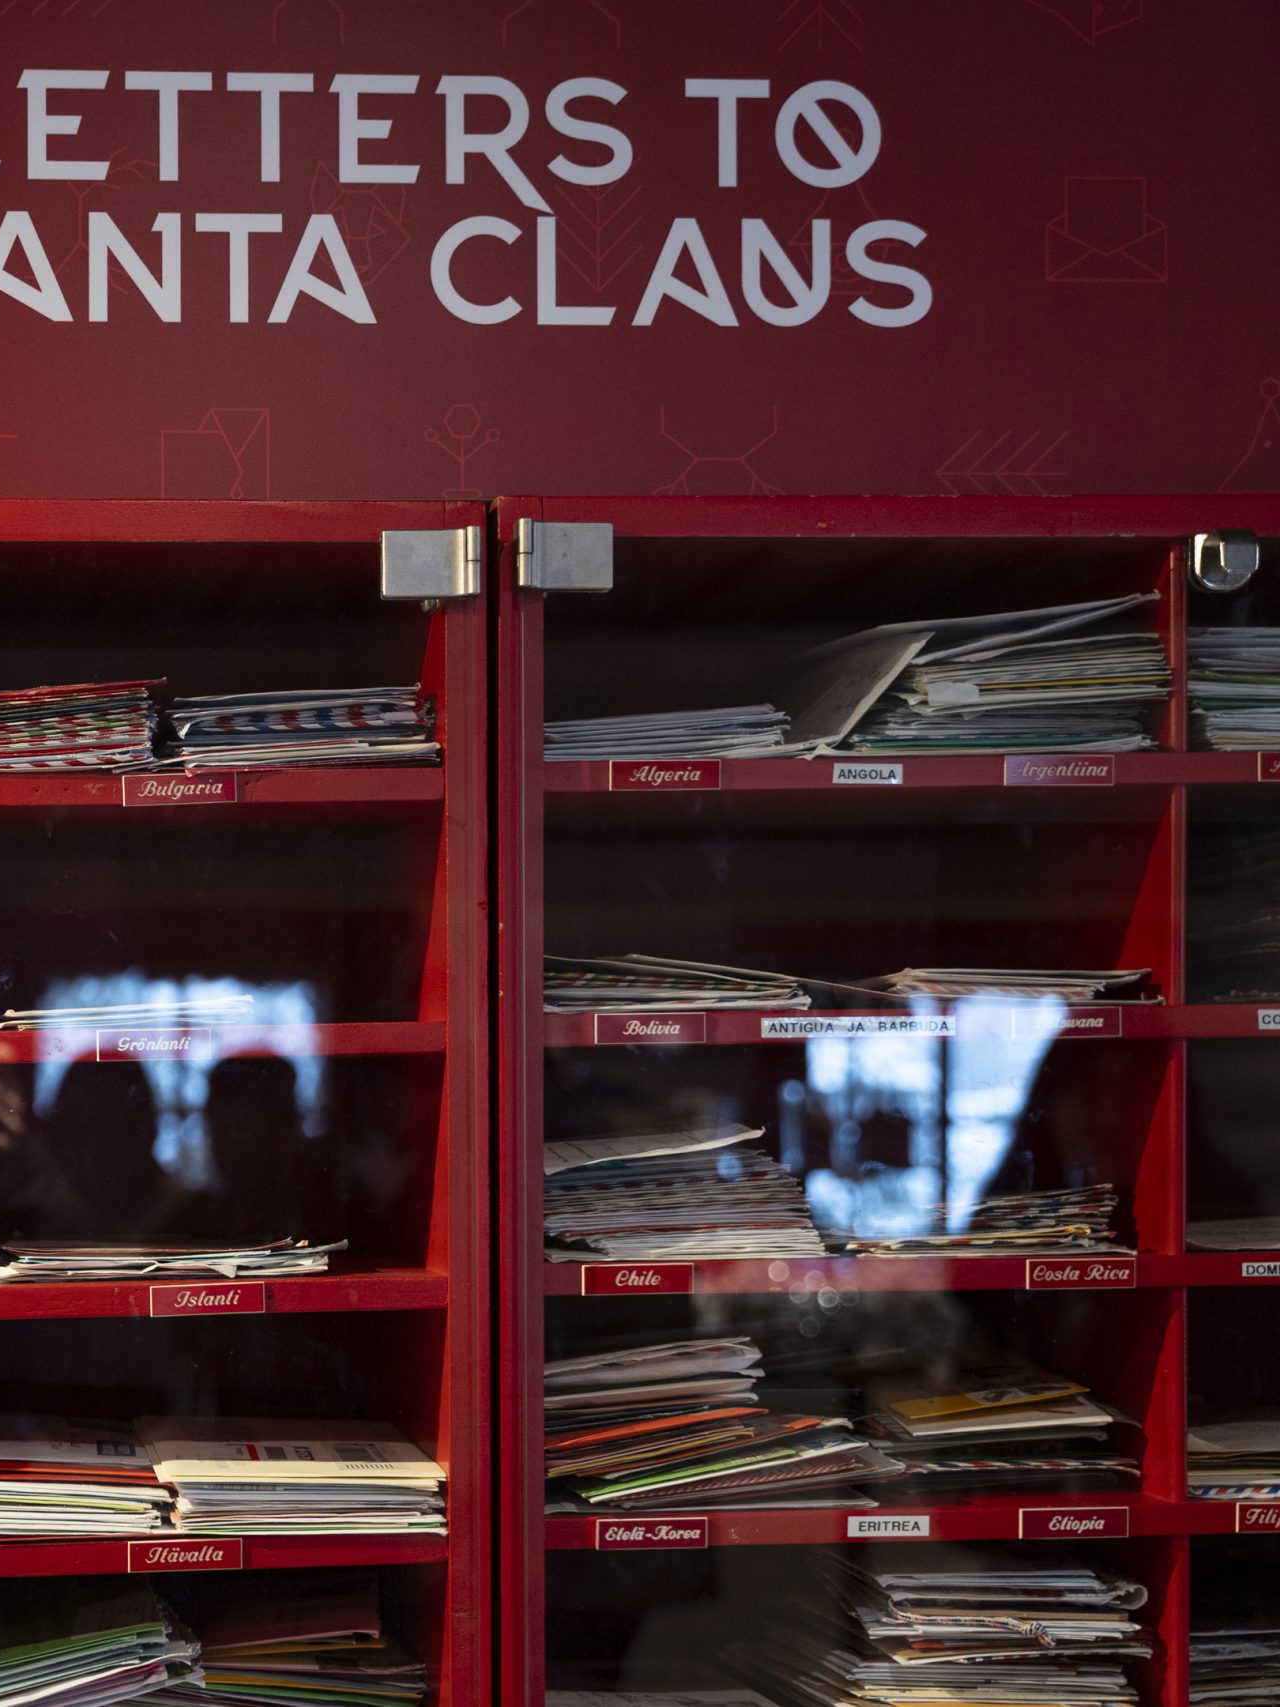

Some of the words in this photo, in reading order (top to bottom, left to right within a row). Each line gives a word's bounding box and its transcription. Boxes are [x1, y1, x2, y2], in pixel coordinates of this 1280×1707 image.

[683, 78, 883, 188] TO
[629, 766, 701, 785] Algeria
[837, 769, 897, 780] ANGOLA
[137, 779, 223, 800] Bulgaria
[623, 1021, 680, 1035] Bolivia
[768, 1022, 834, 1033] ANTIGUA
[847, 1022, 865, 1033] JA
[878, 1021, 949, 1032] BARBUDA
[117, 1037, 191, 1052] Grönlanti
[615, 1270, 661, 1286] Chile
[1033, 1265, 1080, 1281] Costa
[1084, 1264, 1130, 1280] Rica
[174, 1290, 241, 1307] Islanti
[858, 1521, 921, 1532] ERITREA
[1048, 1515, 1105, 1534] Etiopia
[605, 1525, 701, 1541] Etelä-Korea
[145, 1546, 224, 1564] Itävalta
